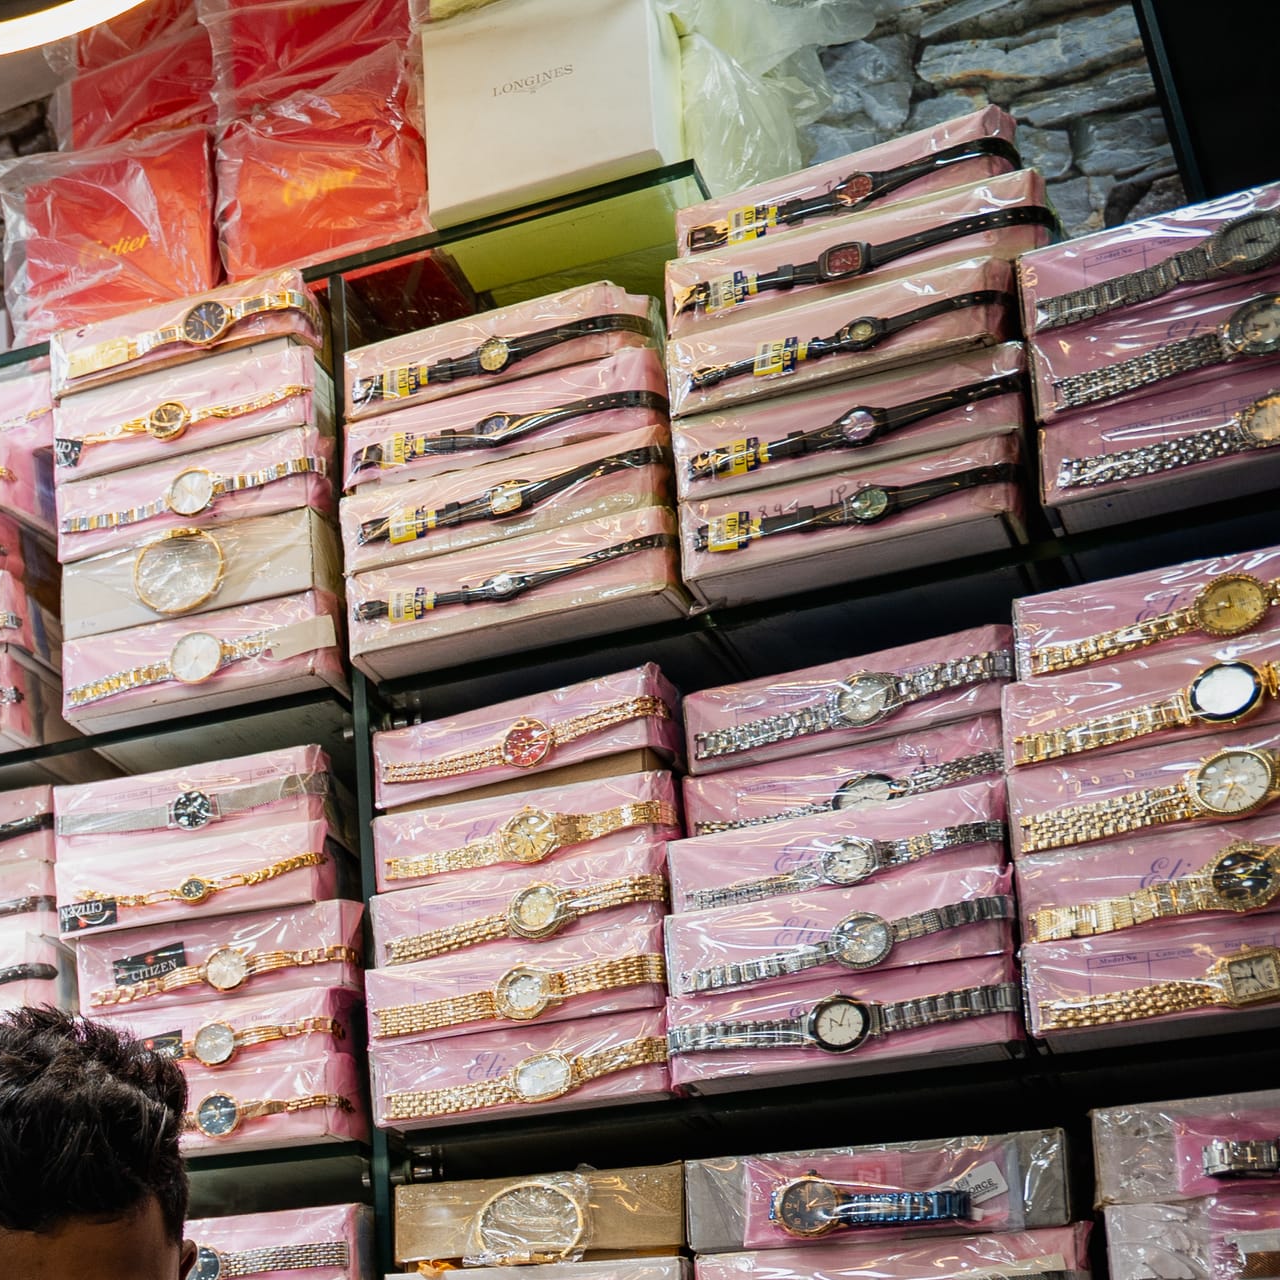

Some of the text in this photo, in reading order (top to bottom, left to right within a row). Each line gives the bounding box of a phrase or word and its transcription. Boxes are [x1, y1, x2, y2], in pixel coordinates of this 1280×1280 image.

[493, 64, 574, 97] LONGINES
[60, 901, 103, 920] CITIZEN
[131, 958, 178, 982] CITIZEN
[968, 1178, 995, 1194] ORCE
